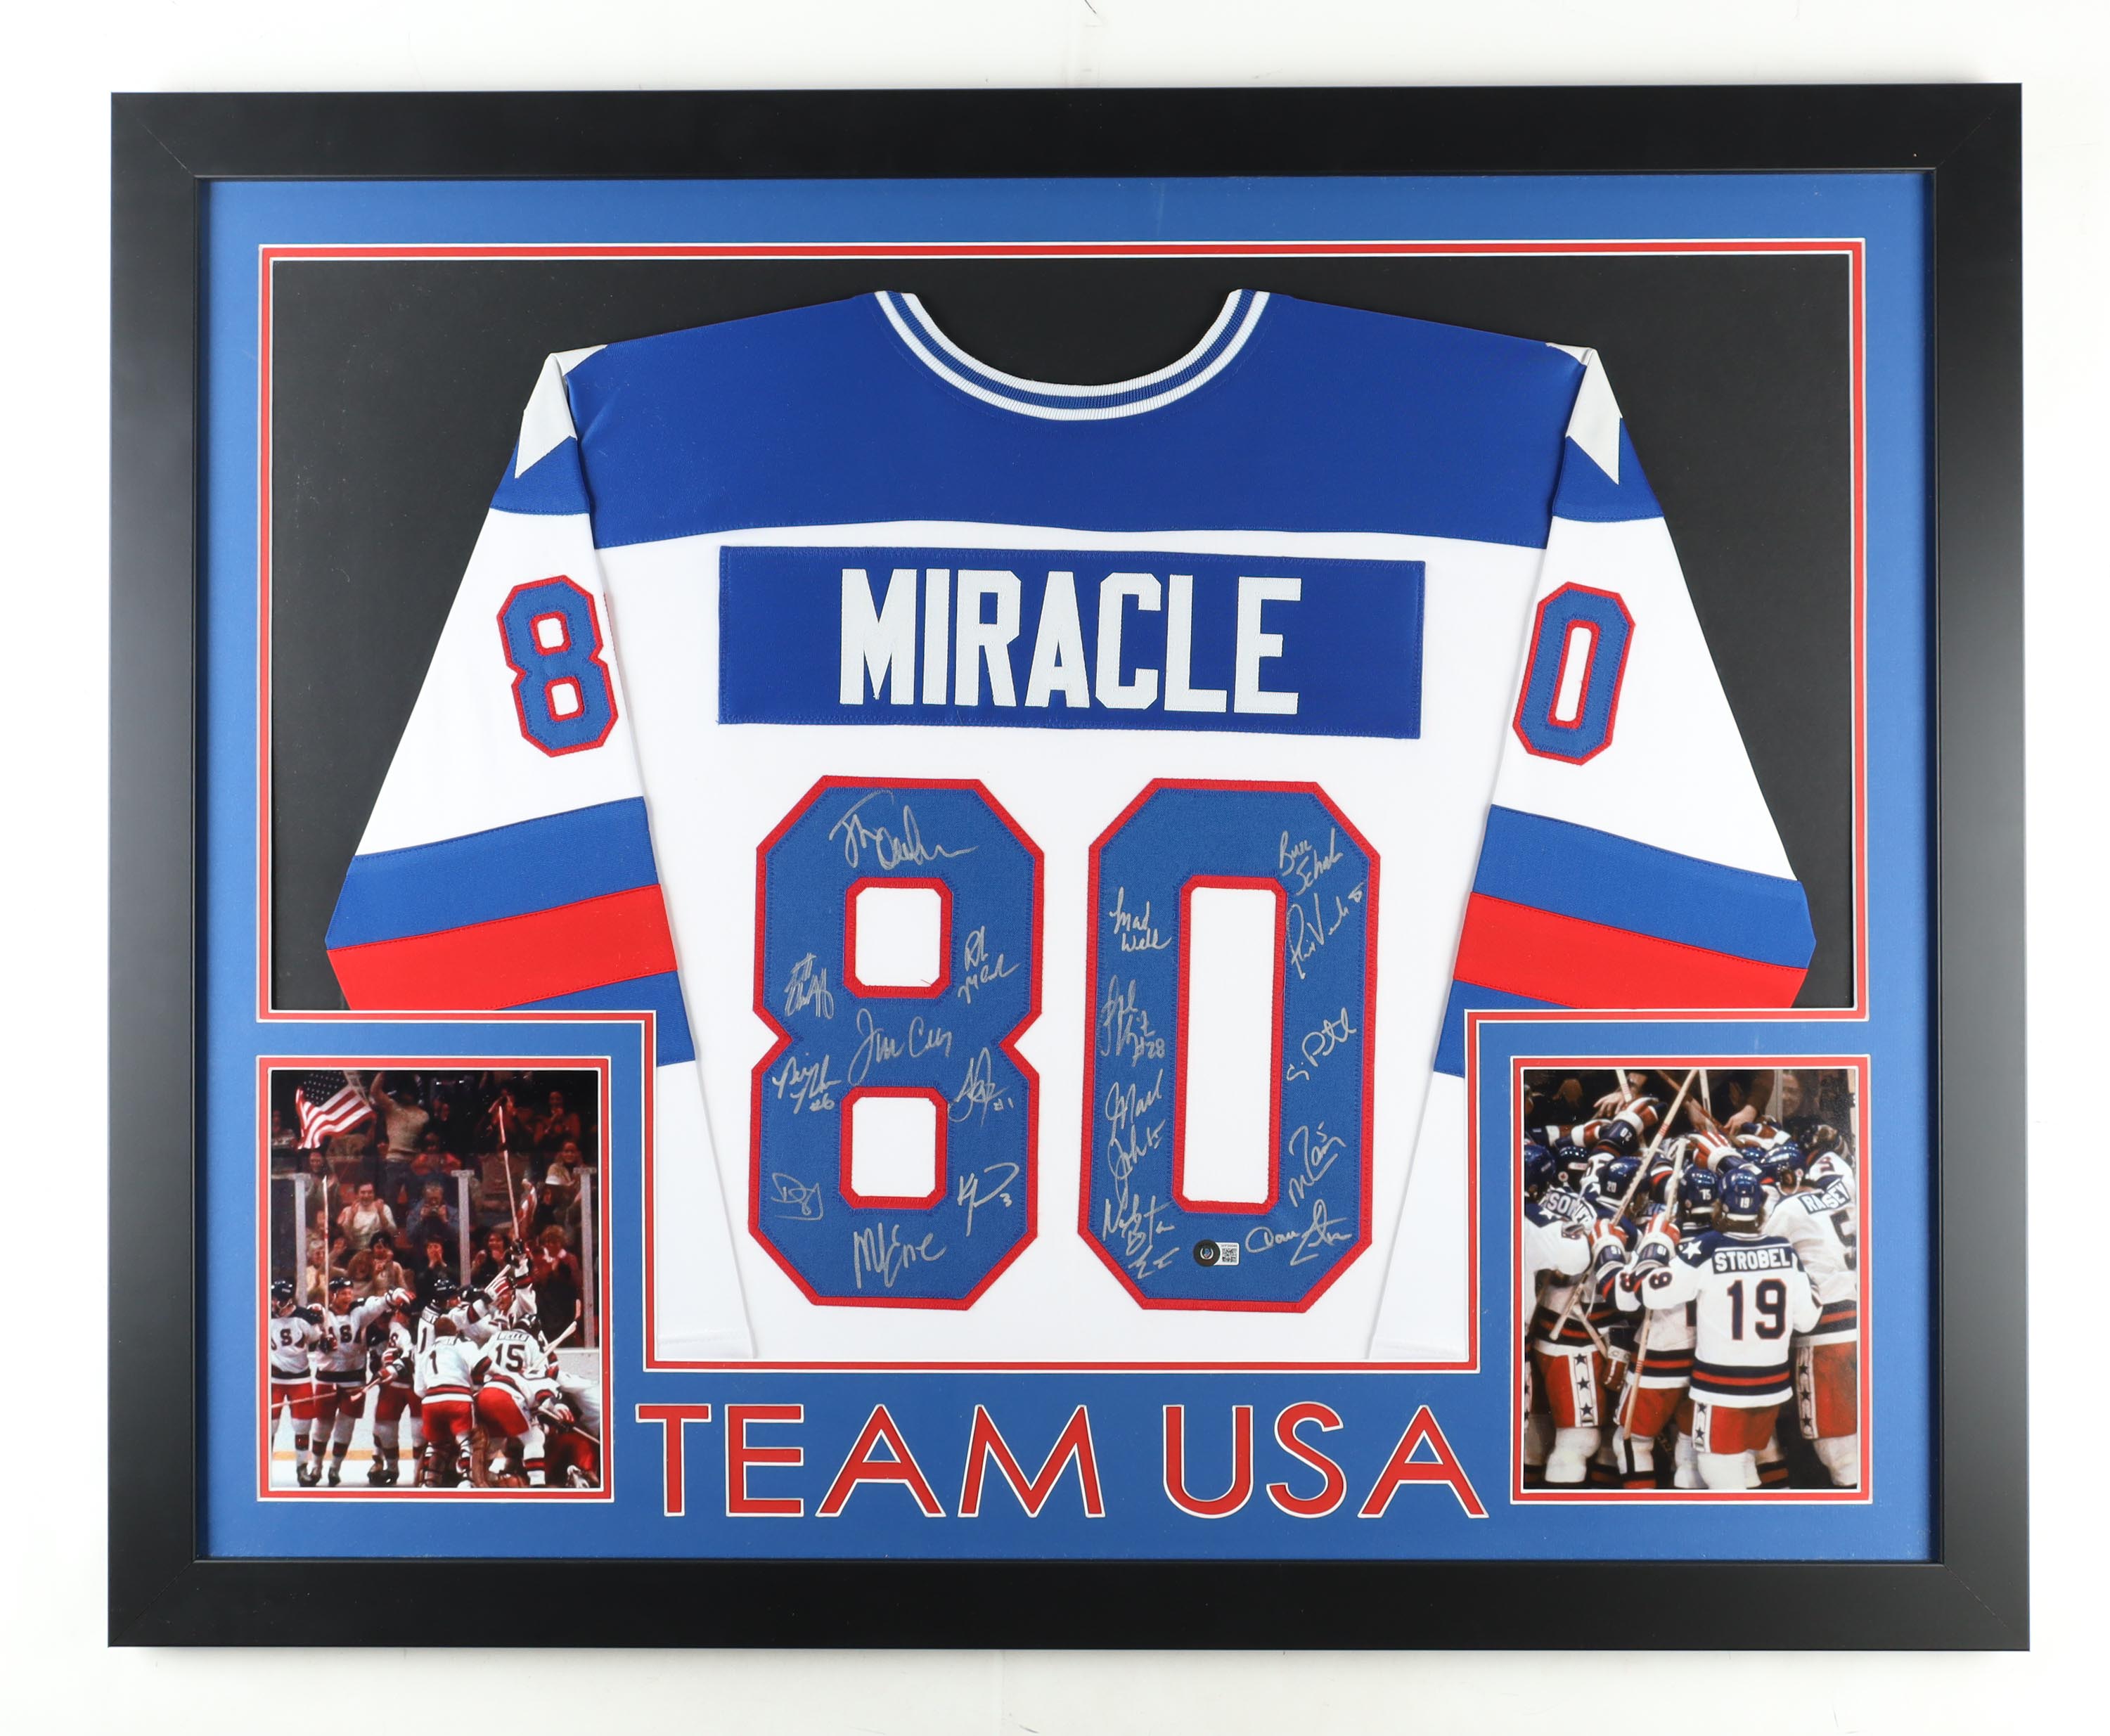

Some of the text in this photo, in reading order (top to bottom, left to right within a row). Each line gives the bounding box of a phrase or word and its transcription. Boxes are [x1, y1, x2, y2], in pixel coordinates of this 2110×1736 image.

[496, 574, 619, 758] 8
[840, 568, 1302, 715] MIRACLE
[1512, 581, 1636, 766] 0
[749, 775, 1380, 1315] 80
[1739, 1197, 1751, 1209] 19
[1713, 1247, 1791, 1272] STROBEL
[1726, 1279, 1787, 1342] 19
[429, 1350, 439, 1375] 1
[495, 1343, 526, 1372] 15
[636, 1401, 1489, 1519] TEAM USA
